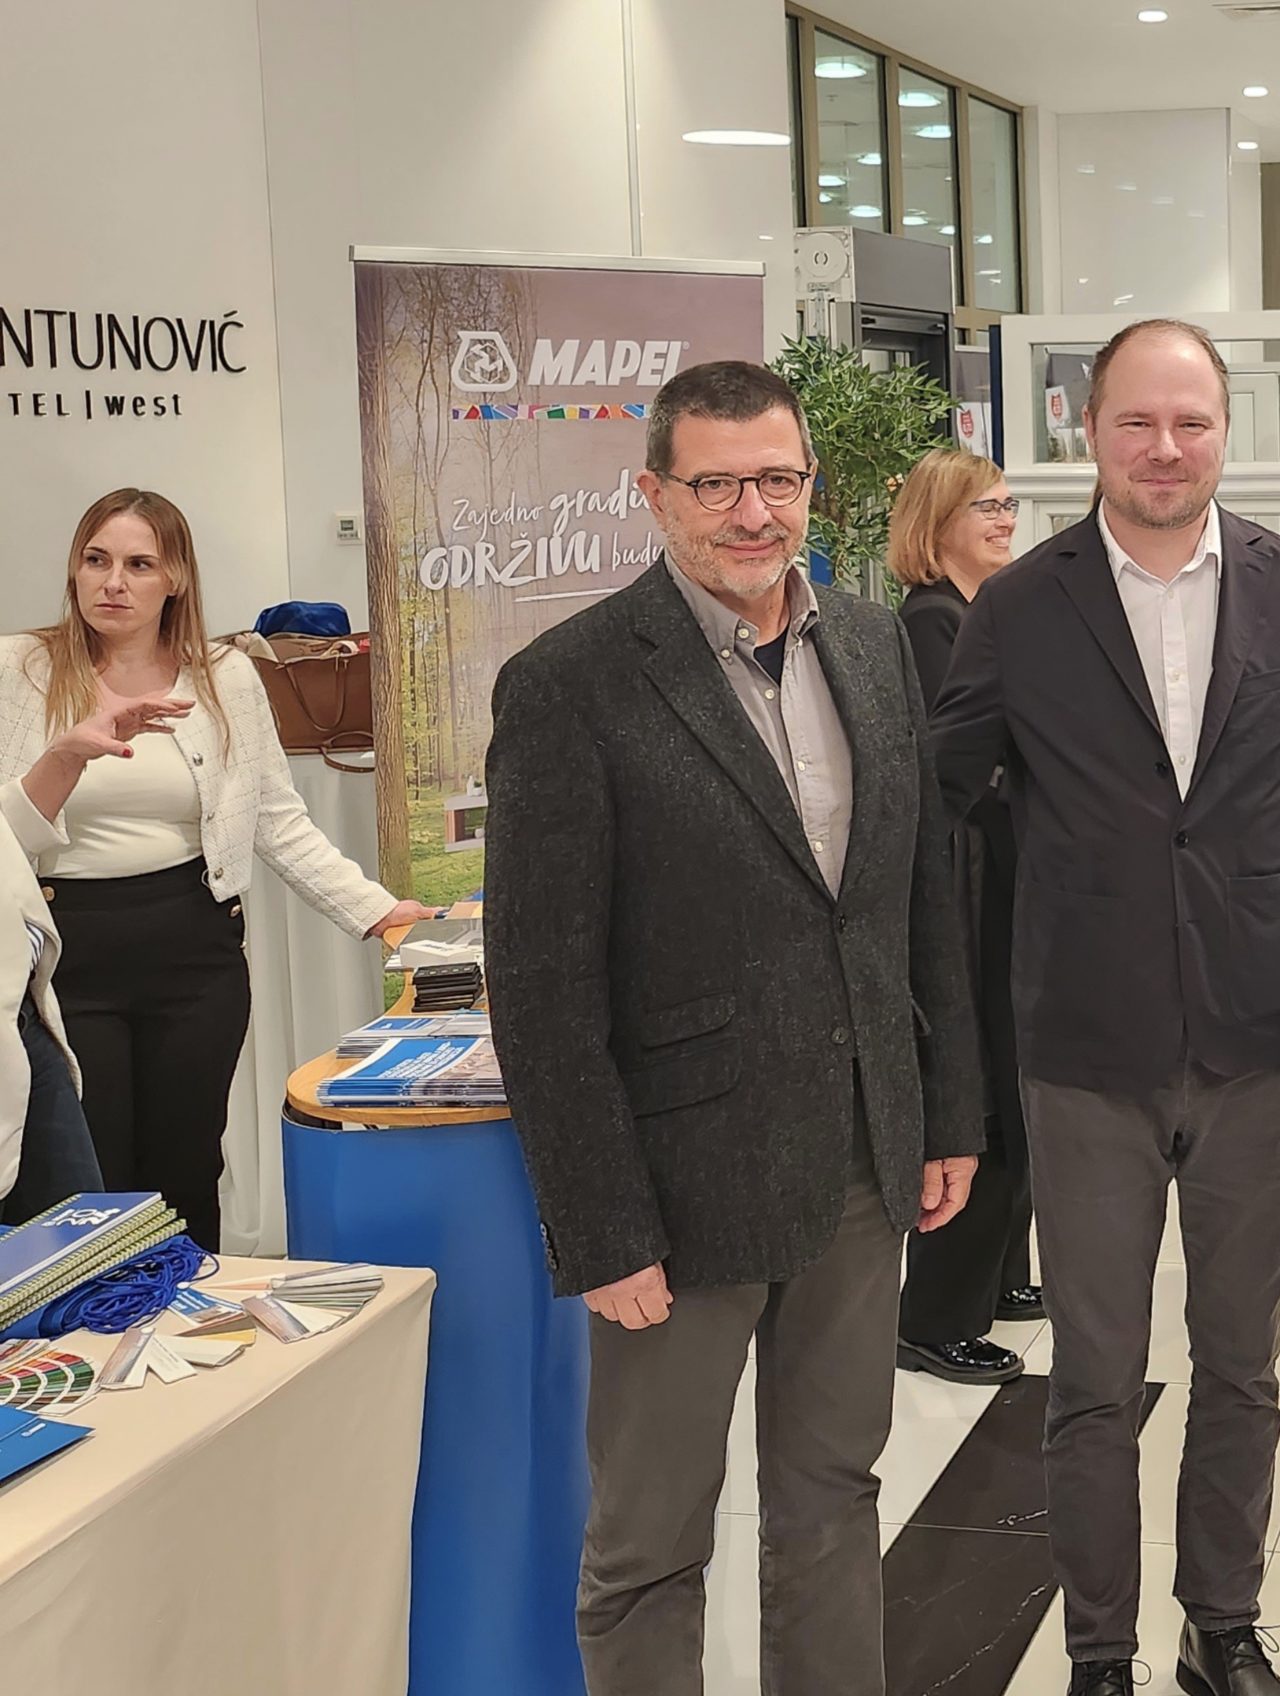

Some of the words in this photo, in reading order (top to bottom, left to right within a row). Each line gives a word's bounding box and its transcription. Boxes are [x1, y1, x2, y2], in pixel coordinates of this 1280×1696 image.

[0, 307, 247, 373] NTUNOVIĆ
[528, 338, 683, 387] MAPEI
[8, 392, 70, 417] TEL
[104, 393, 183, 417] west
[452, 491, 545, 542] Zajedno
[550, 468, 650, 536] gradi
[419, 530, 600, 591] ODRŽIVU
